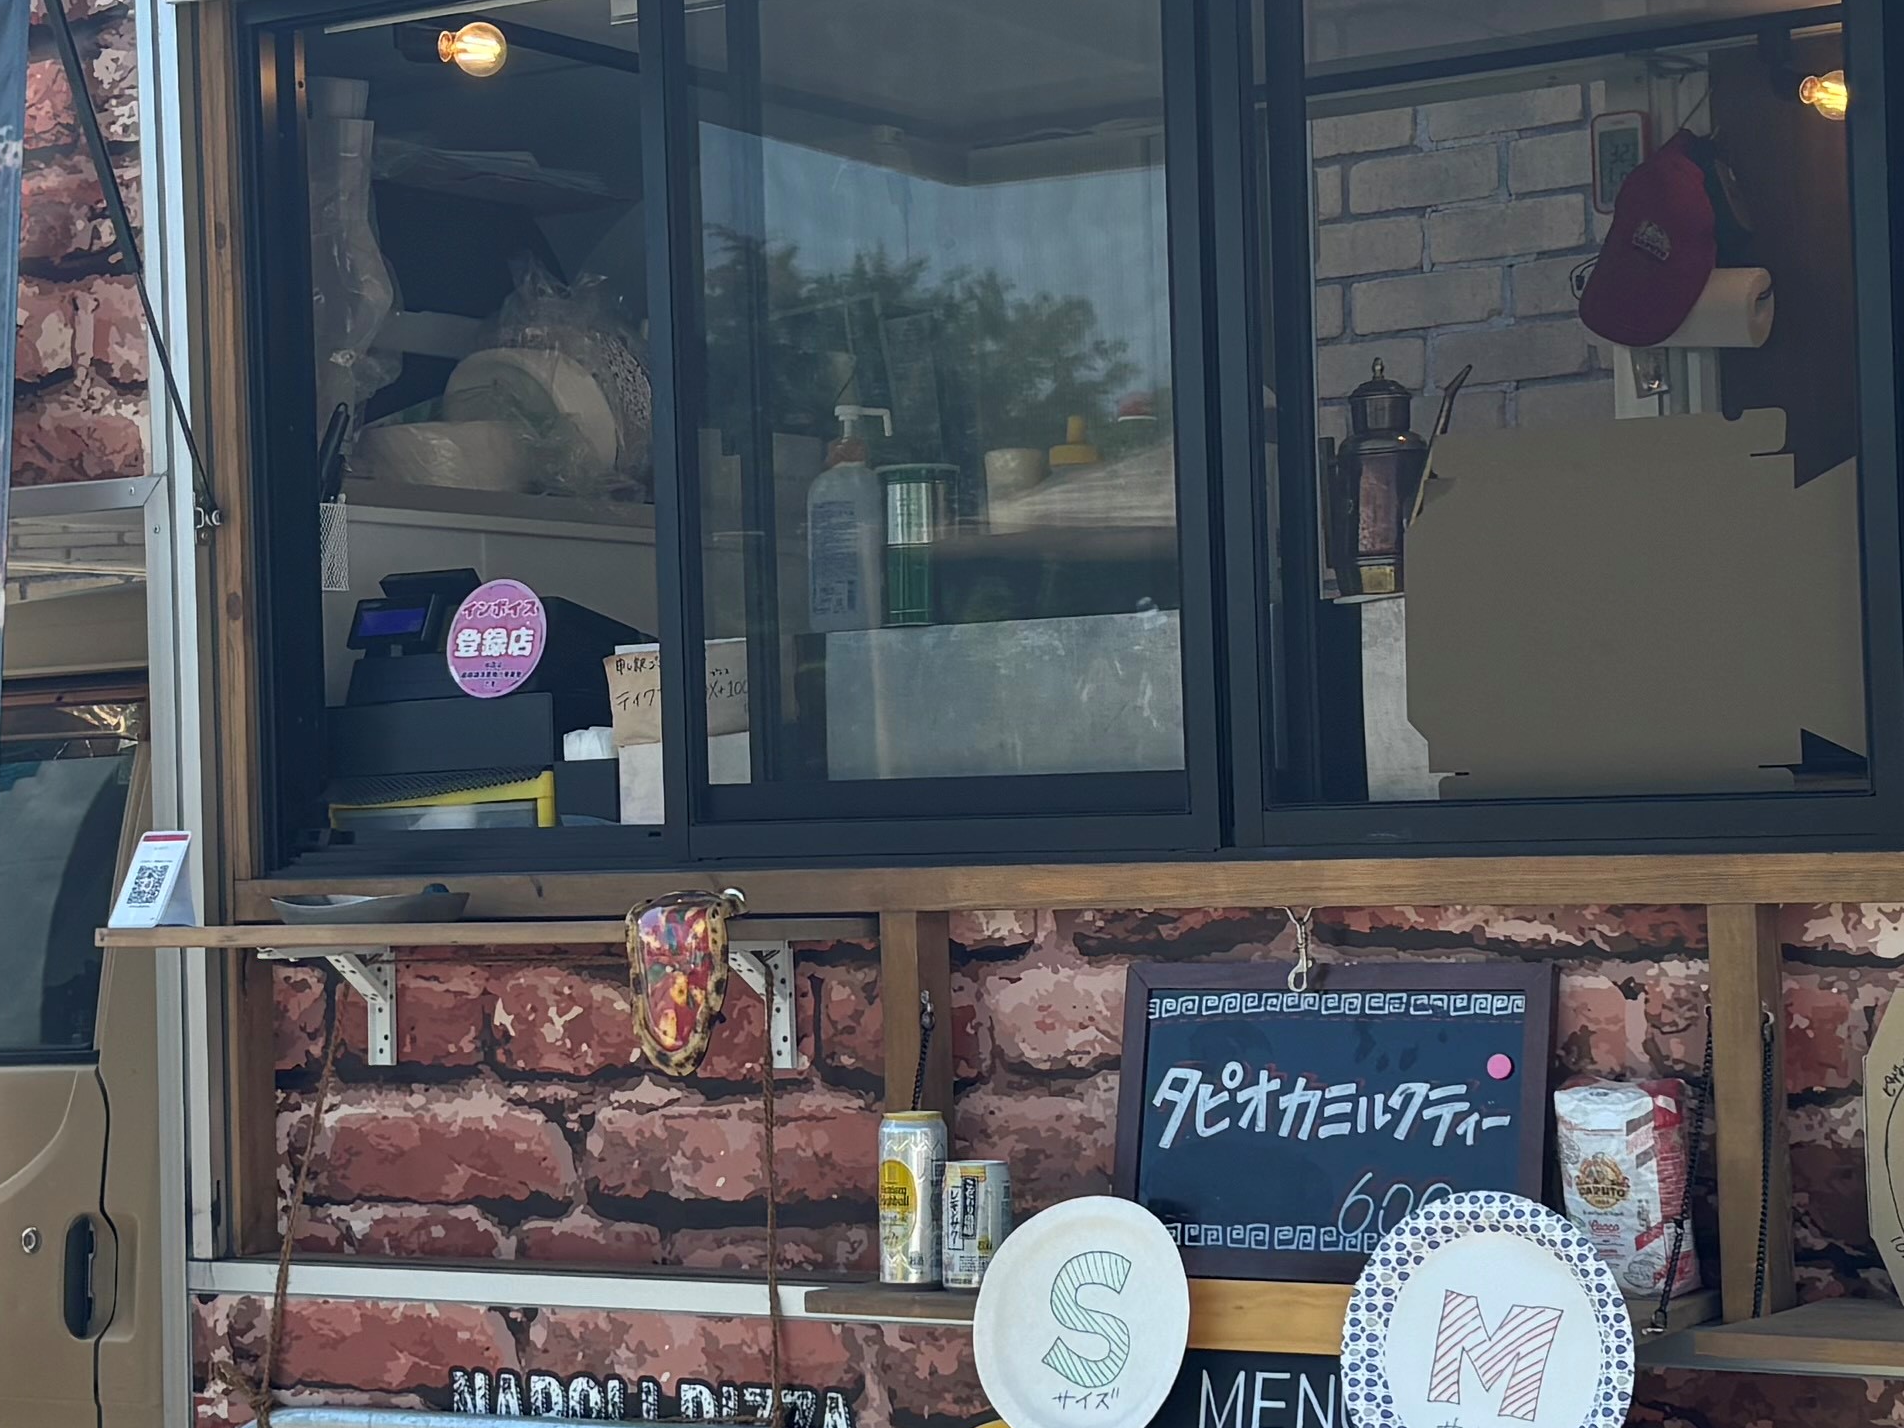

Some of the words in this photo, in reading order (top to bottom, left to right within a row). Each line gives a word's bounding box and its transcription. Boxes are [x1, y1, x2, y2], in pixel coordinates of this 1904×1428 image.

[461, 598, 538, 620] インボイス
[454, 627, 534, 657] 登録店
[1152, 1060, 1512, 1149] タピオカミルクティー
[1578, 1186, 1626, 1199] CAPUTO
[1040, 1249, 1132, 1389] S
[1427, 1289, 1564, 1423] M
[1050, 1387, 1121, 1412] サイズ
